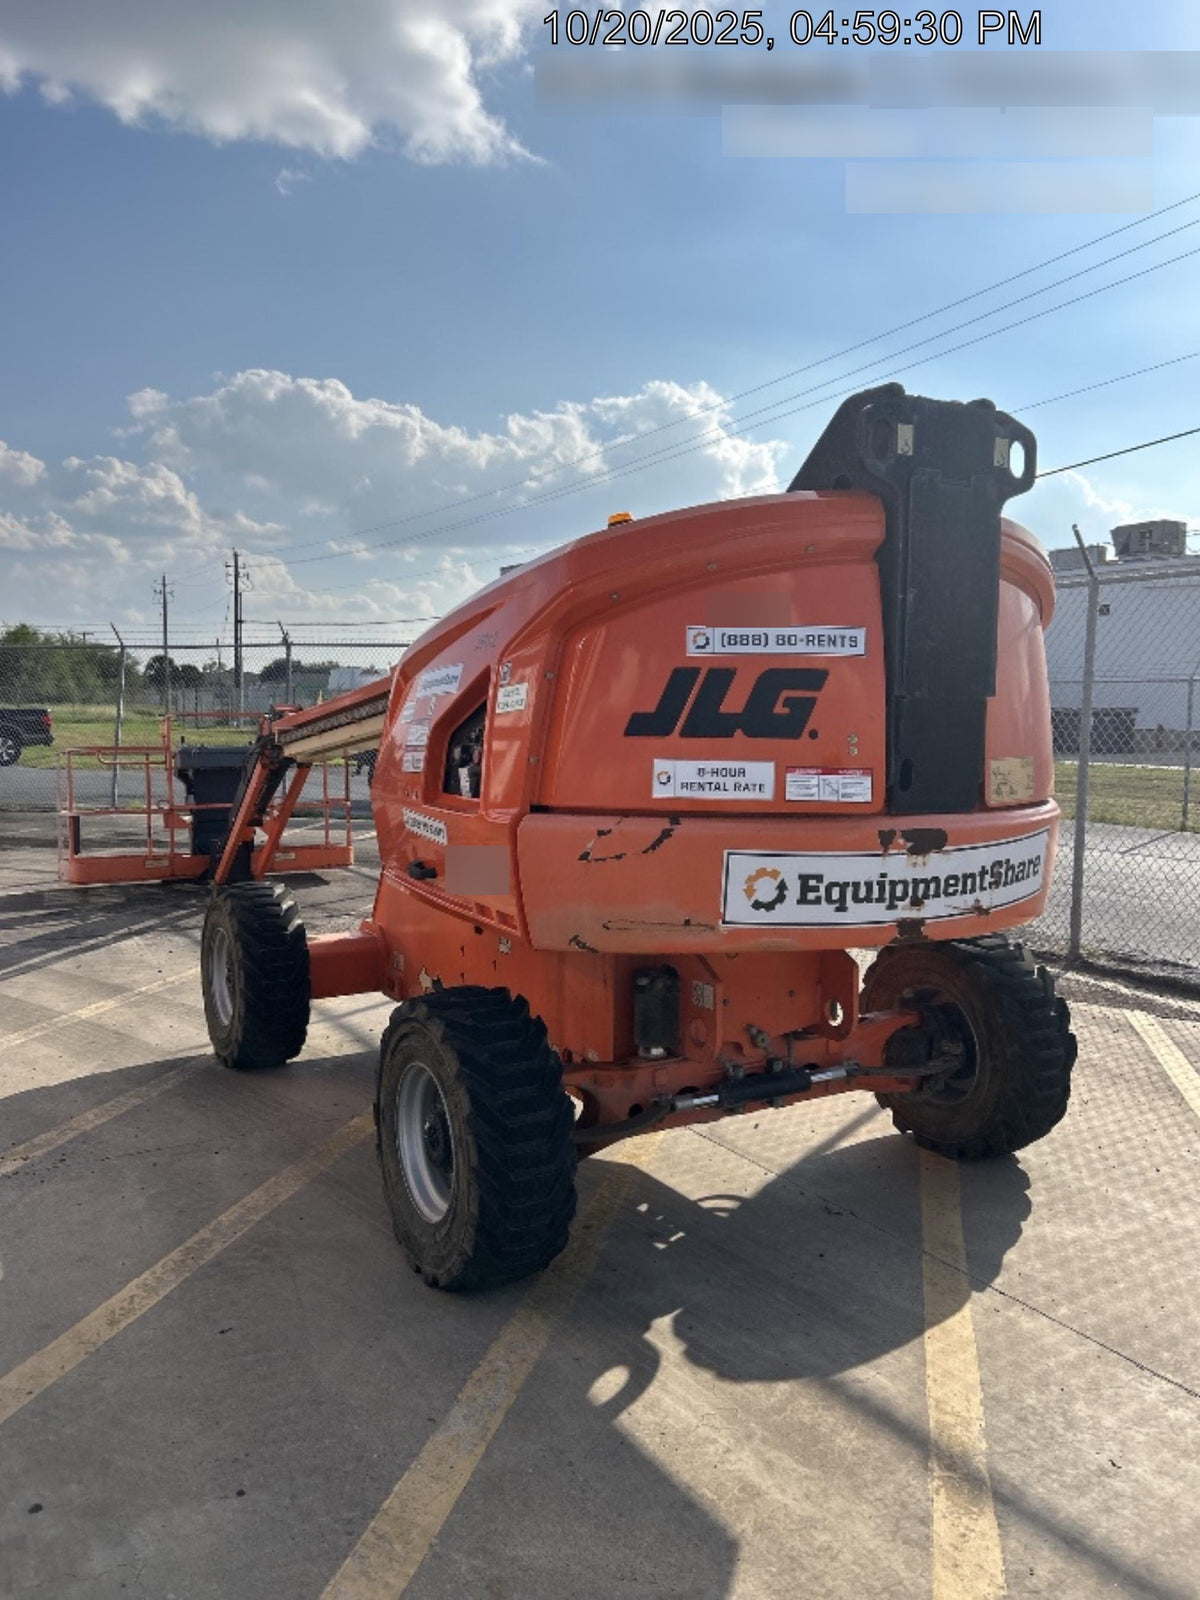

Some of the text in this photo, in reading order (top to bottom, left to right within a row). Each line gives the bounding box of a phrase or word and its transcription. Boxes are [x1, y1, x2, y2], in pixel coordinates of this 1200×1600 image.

[720, 633, 859, 648] (888) 80-RENTS
[697, 767, 746, 778] 8-HOUR
[680, 781, 766, 794] RENTAL RATE
[796, 854, 1041, 912] EquipmentShare
